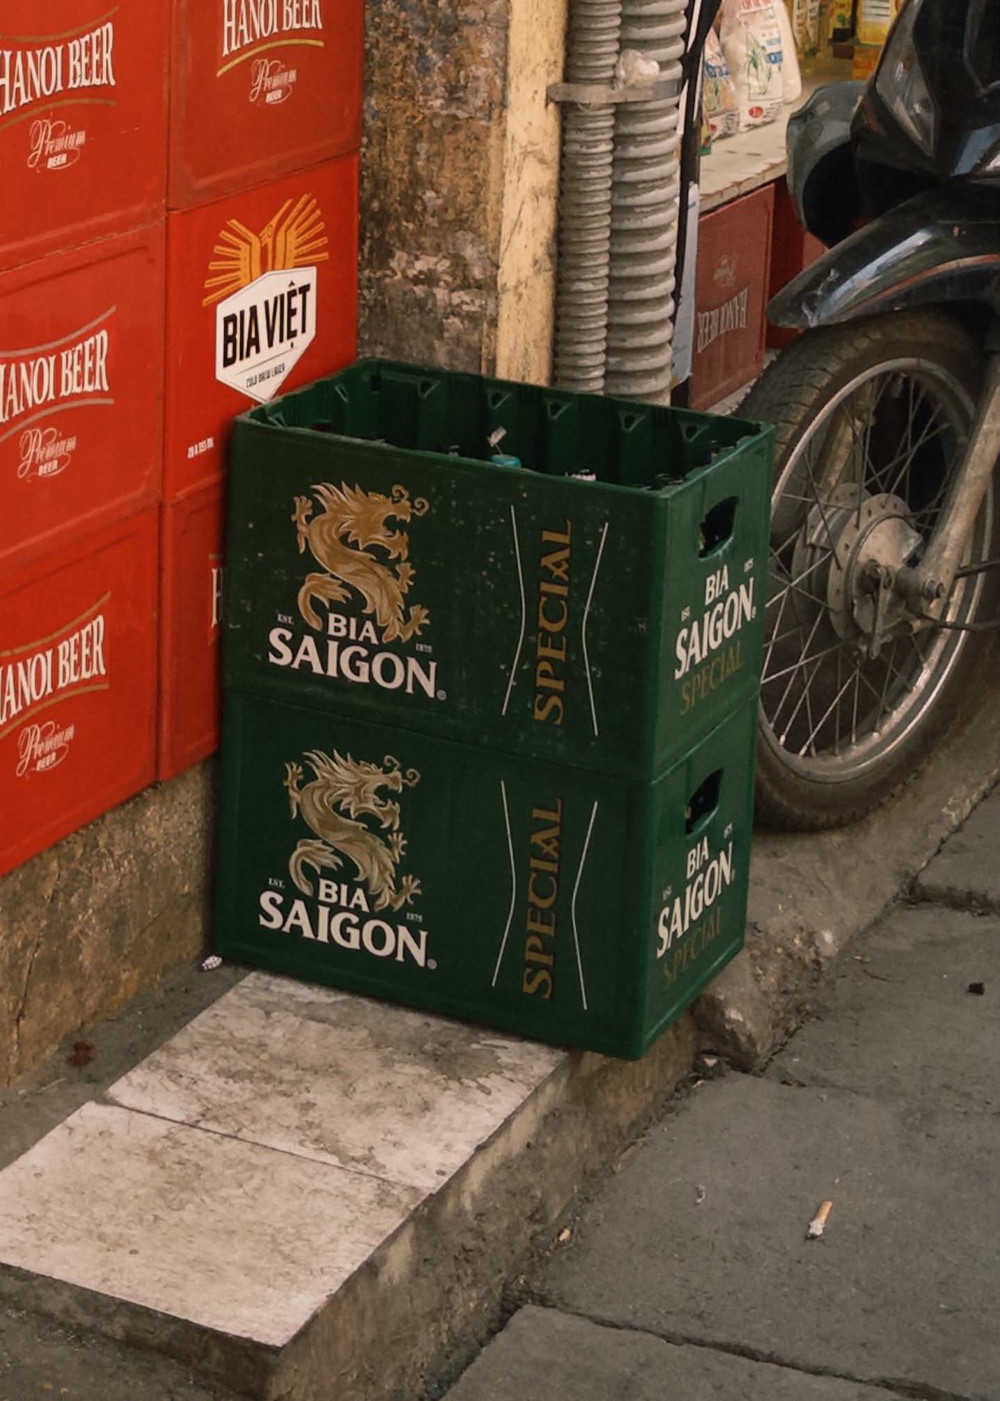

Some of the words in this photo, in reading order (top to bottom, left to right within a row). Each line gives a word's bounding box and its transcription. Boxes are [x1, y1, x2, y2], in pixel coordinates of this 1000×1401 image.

[67, 21, 116, 90] BEER
[47, 153, 68, 169] BEER
[222, 303, 261, 369] BIA
[264, 280, 311, 349] VIỆT
[59, 328, 110, 398] BEER
[37, 459, 59, 477] BEER
[704, 564, 729, 606] BIA
[57, 614, 106, 690] BEER
[327, 612, 379, 645] BIA
[533, 518, 572, 726] SPECIAL
[674, 576, 755, 681] SAIGON
[268, 627, 438, 699] SAIGON
[680, 640, 744, 717] SPECIAL
[36, 751, 57, 772] BEER
[686, 835, 709, 880] BIA
[259, 890, 429, 969] SAIGON
[318, 877, 370, 913] BIA
[523, 797, 563, 1000] SPECIAL
[656, 841, 733, 960] SAIGON
[662, 906, 722, 991] SPECIAL
